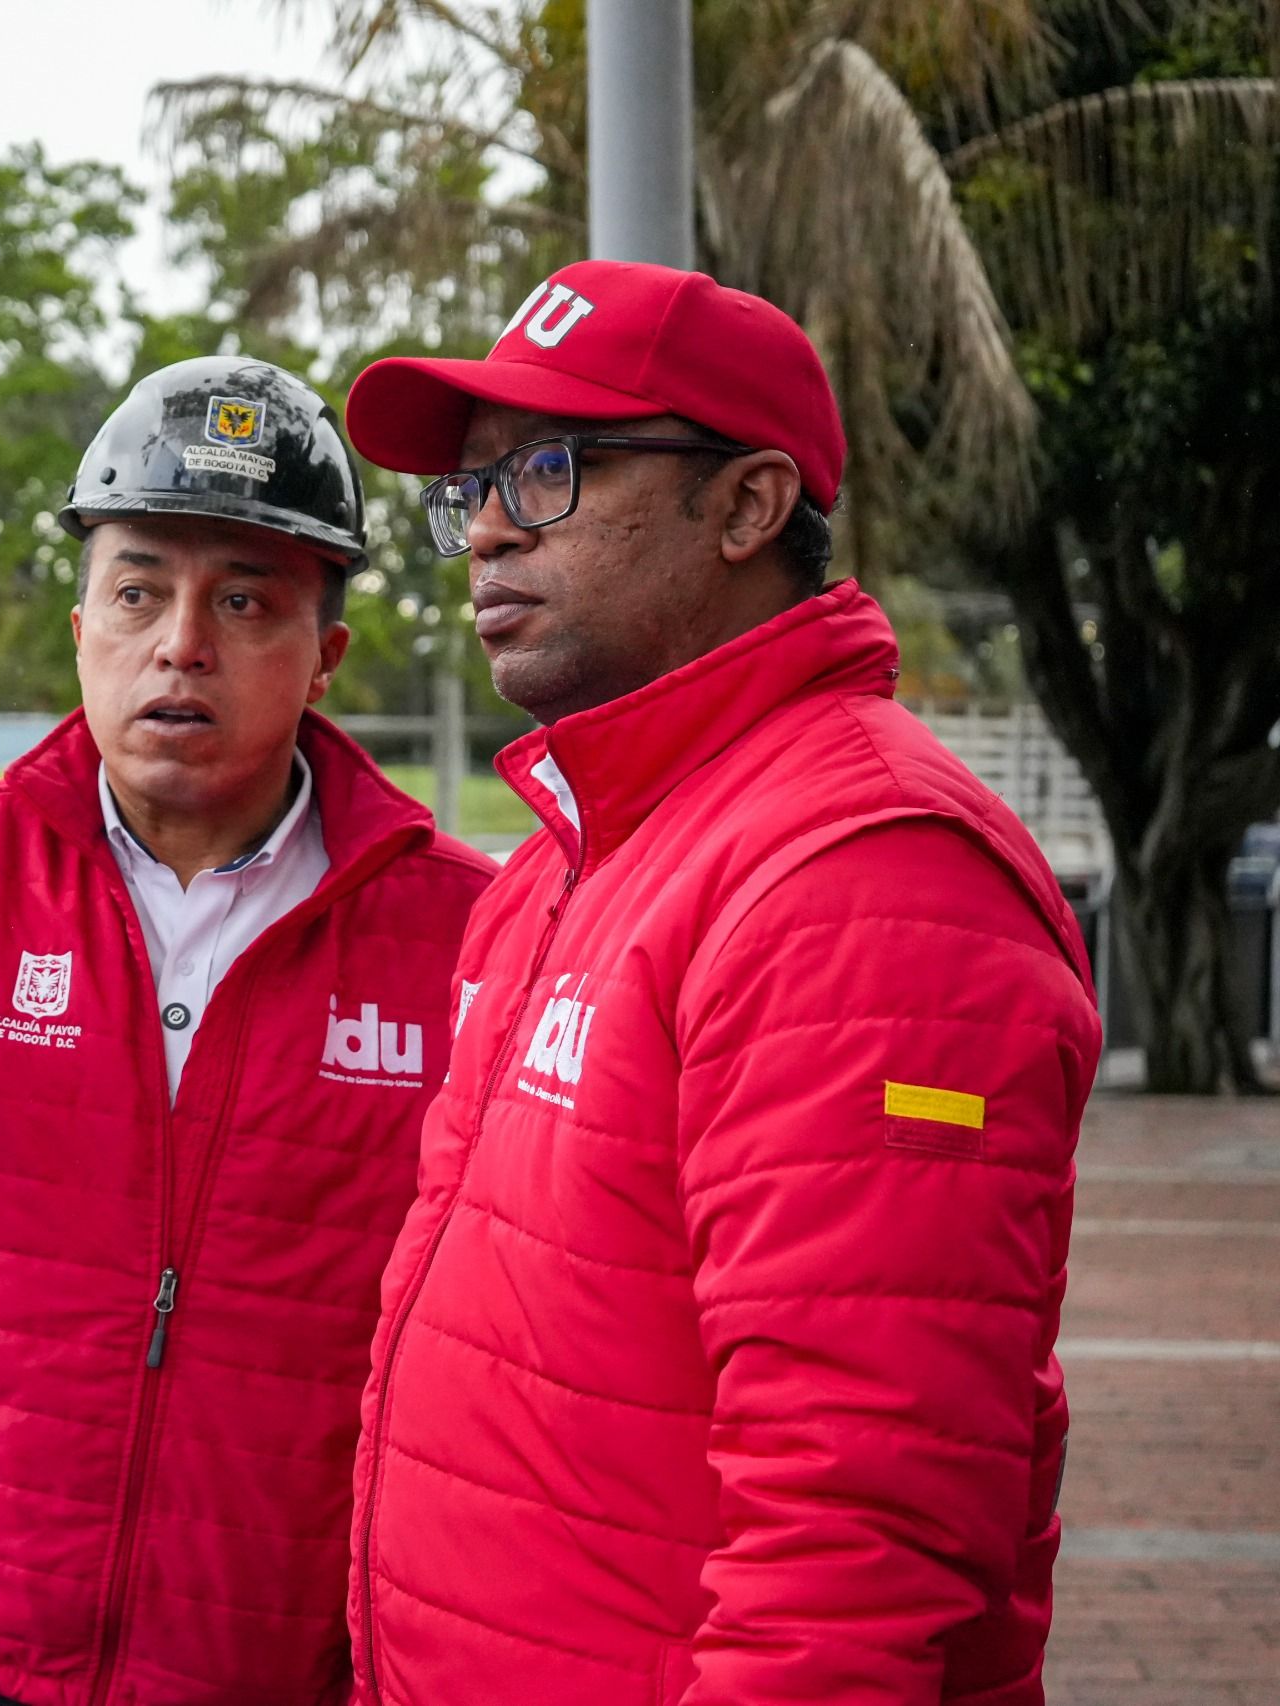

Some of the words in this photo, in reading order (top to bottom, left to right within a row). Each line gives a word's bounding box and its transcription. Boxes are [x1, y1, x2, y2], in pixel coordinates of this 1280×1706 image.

[188, 458, 202, 466] DE
[238, 452, 274, 469] MAYOR
[45, 1024, 82, 1037] MAYOR
[321, 993, 423, 1074] idu
[55, 1037, 76, 1049] D.C.
